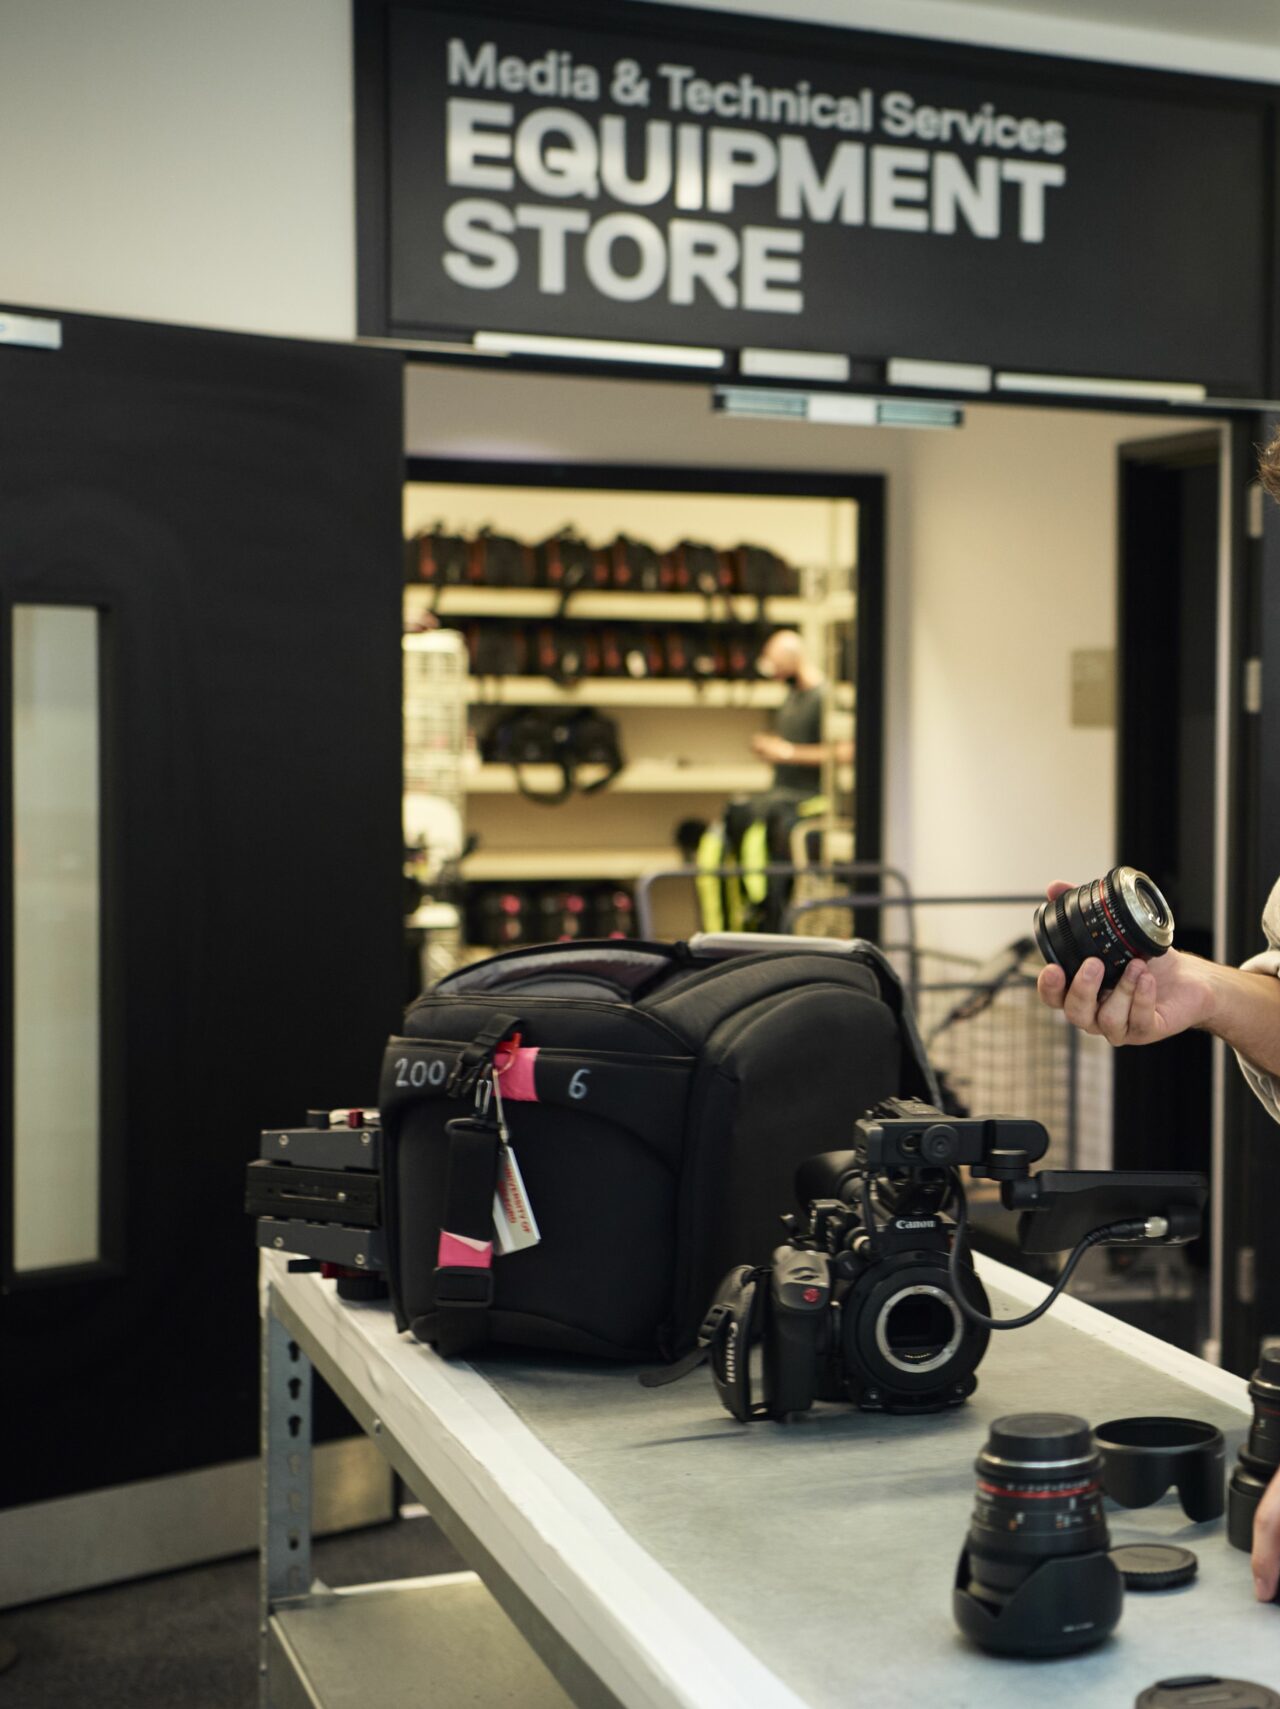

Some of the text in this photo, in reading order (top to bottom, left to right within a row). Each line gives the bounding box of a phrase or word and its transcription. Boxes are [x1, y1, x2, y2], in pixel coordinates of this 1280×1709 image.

[447, 38, 1067, 155] Media & Technical Services
[446, 98, 1066, 243] EQUIPMENT
[442, 198, 804, 314] STORE
[394, 1056, 447, 1088] 200
[895, 1219, 936, 1230] Canon
